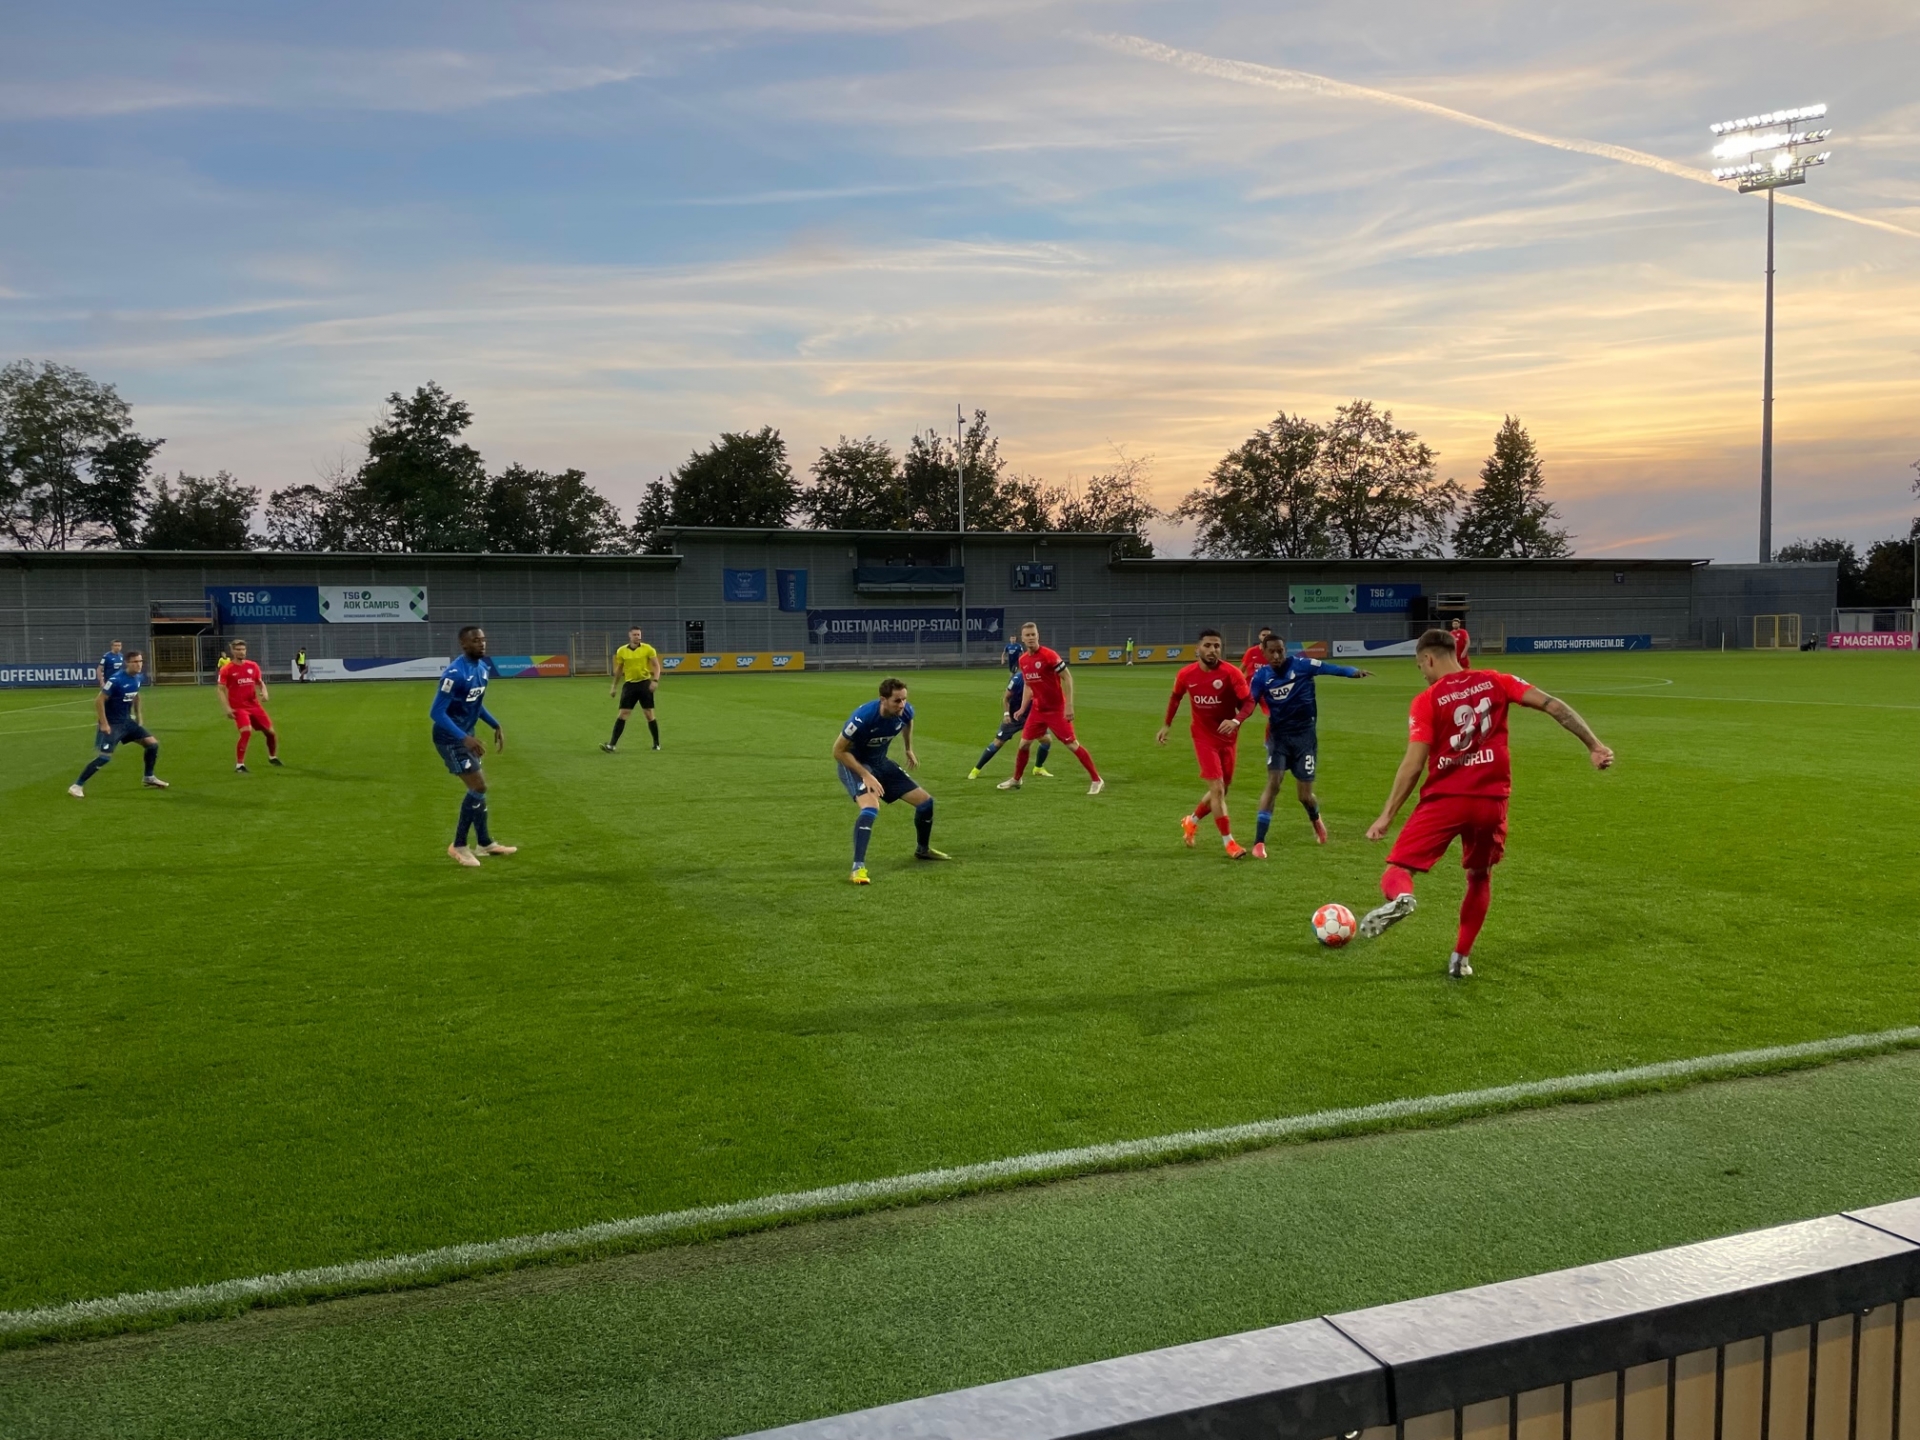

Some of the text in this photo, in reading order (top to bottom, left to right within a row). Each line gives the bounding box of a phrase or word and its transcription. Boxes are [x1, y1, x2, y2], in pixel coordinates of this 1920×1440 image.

[343, 591, 360, 600] TSG
[1303, 588, 1315, 596] TSG
[1370, 588, 1385, 598] TSG
[229, 592, 255, 604] TSG
[1369, 598, 1409, 608] AKADEMIE
[343, 600, 399, 609] AOK CAMPUS
[229, 605, 297, 617] AKADEMIE
[831, 618, 982, 634] DIETMAR-HOPP-STADON
[1534, 639, 1625, 650] SHOP.TSG-HOFFENHEIM.DE
[1843, 635, 1895, 646] MAGENTA
[1079, 652, 1092, 660] SAP
[1108, 651, 1121, 659] SAP
[1138, 650, 1151, 659] SAP
[1167, 649, 1180, 658] SAP
[663, 659, 680, 668] SAP
[700, 658, 718, 668] SAP
[736, 657, 754, 667] SAP
[772, 656, 789, 666] SAP
[1271, 687, 1290, 698] SAP
[1437, 680, 1494, 706] KSV HESSE KASSEL
[1193, 695, 1222, 704] OKAL
[1449, 697, 1493, 752] 31
